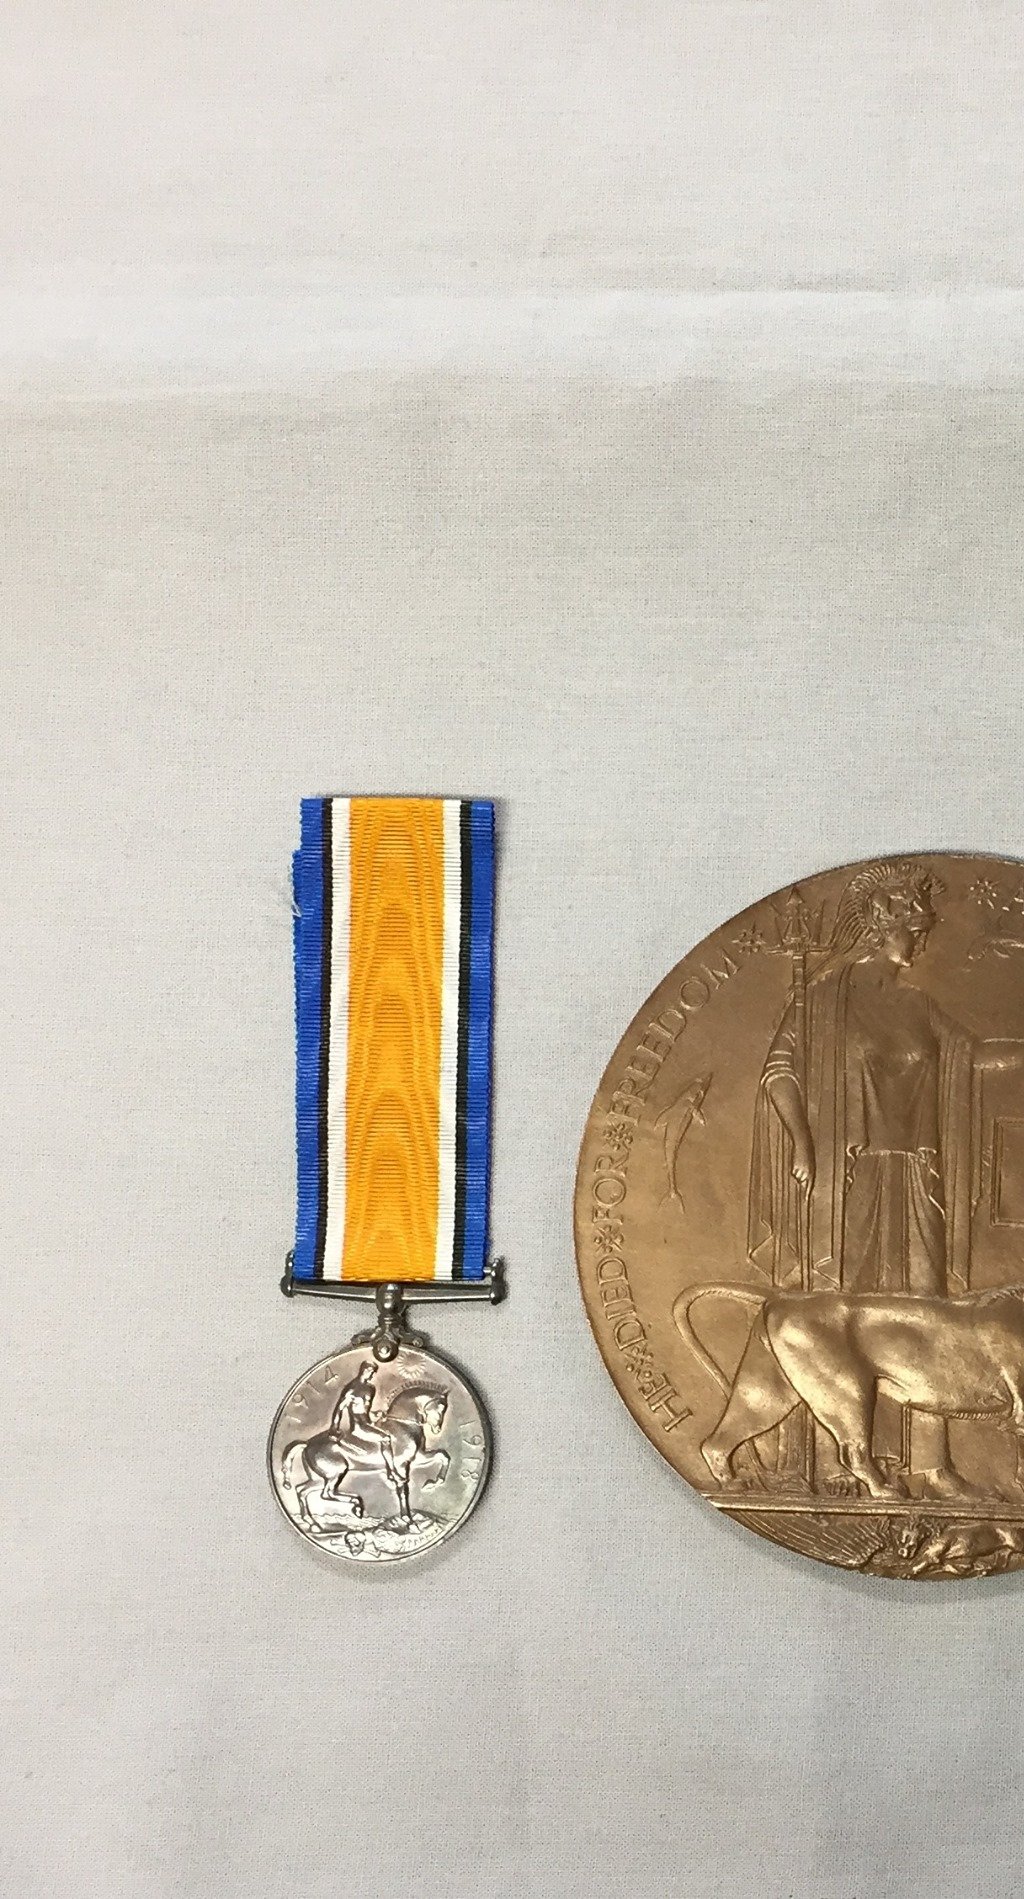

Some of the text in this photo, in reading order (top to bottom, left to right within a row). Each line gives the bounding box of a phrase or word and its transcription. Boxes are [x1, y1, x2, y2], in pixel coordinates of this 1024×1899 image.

[604, 947, 743, 1127] FREEDOM
[591, 1146, 630, 1225] FOR
[596, 1256, 648, 1351] DIED
[283, 1364, 340, 1424] 1914
[636, 1371, 694, 1433] HE
[458, 1419, 482, 1481] 1918
